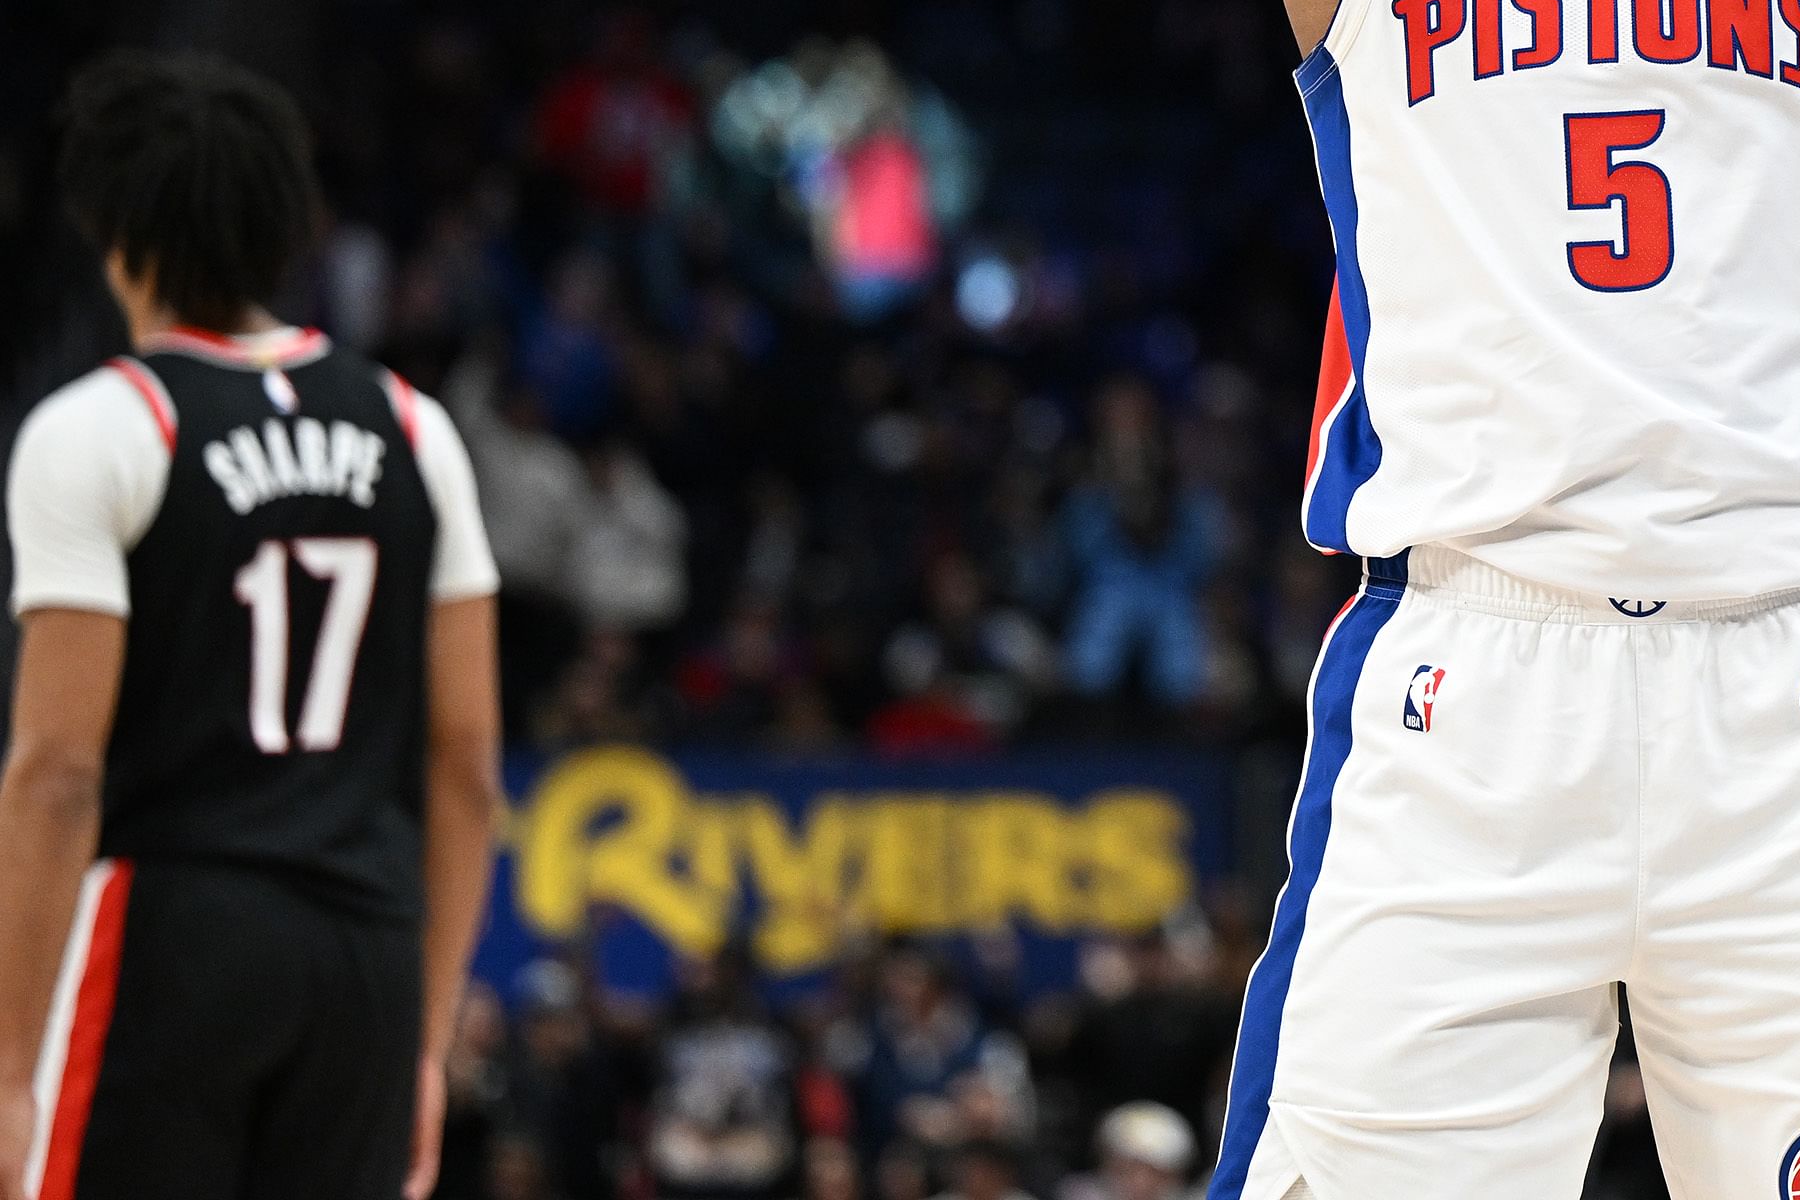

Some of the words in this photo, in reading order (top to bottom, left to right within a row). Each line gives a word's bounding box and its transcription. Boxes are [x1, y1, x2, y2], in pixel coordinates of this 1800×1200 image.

[1563, 109, 1675, 293] 5
[203, 416, 386, 516] SHARPE
[234, 536, 379, 754] 17
[1406, 714, 1421, 729] NBA
